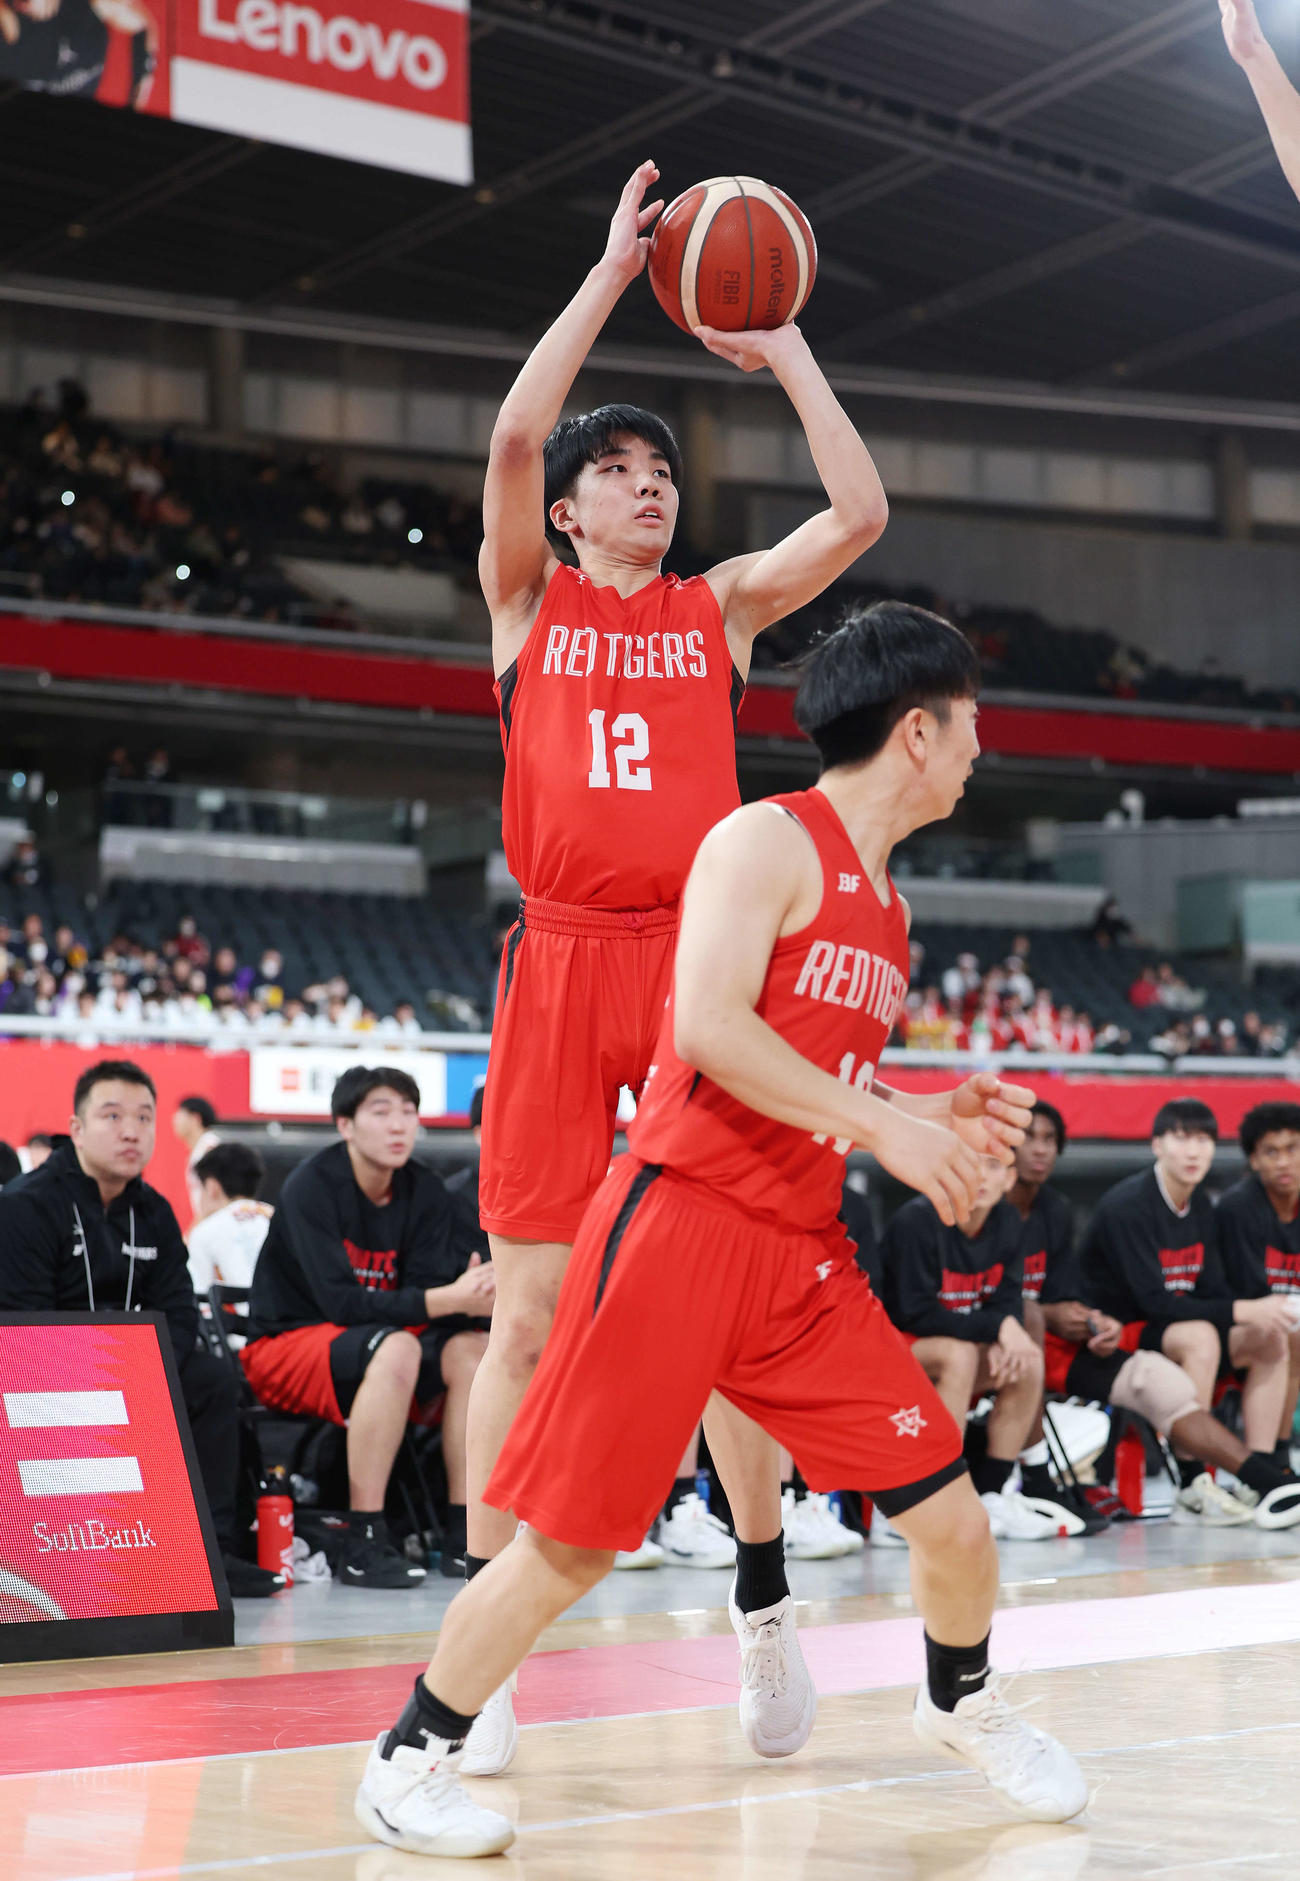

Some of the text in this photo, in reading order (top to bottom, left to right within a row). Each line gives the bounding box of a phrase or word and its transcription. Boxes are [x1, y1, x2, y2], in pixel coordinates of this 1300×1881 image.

[198, 0, 448, 90] Lenovo
[723, 270, 740, 305] FIBA
[765, 247, 785, 319] molten
[588, 708, 652, 791] 12
[838, 872, 860, 893] BF
[793, 939, 871, 1010] RED
[33, 1520, 157, 1551] SoftBank
